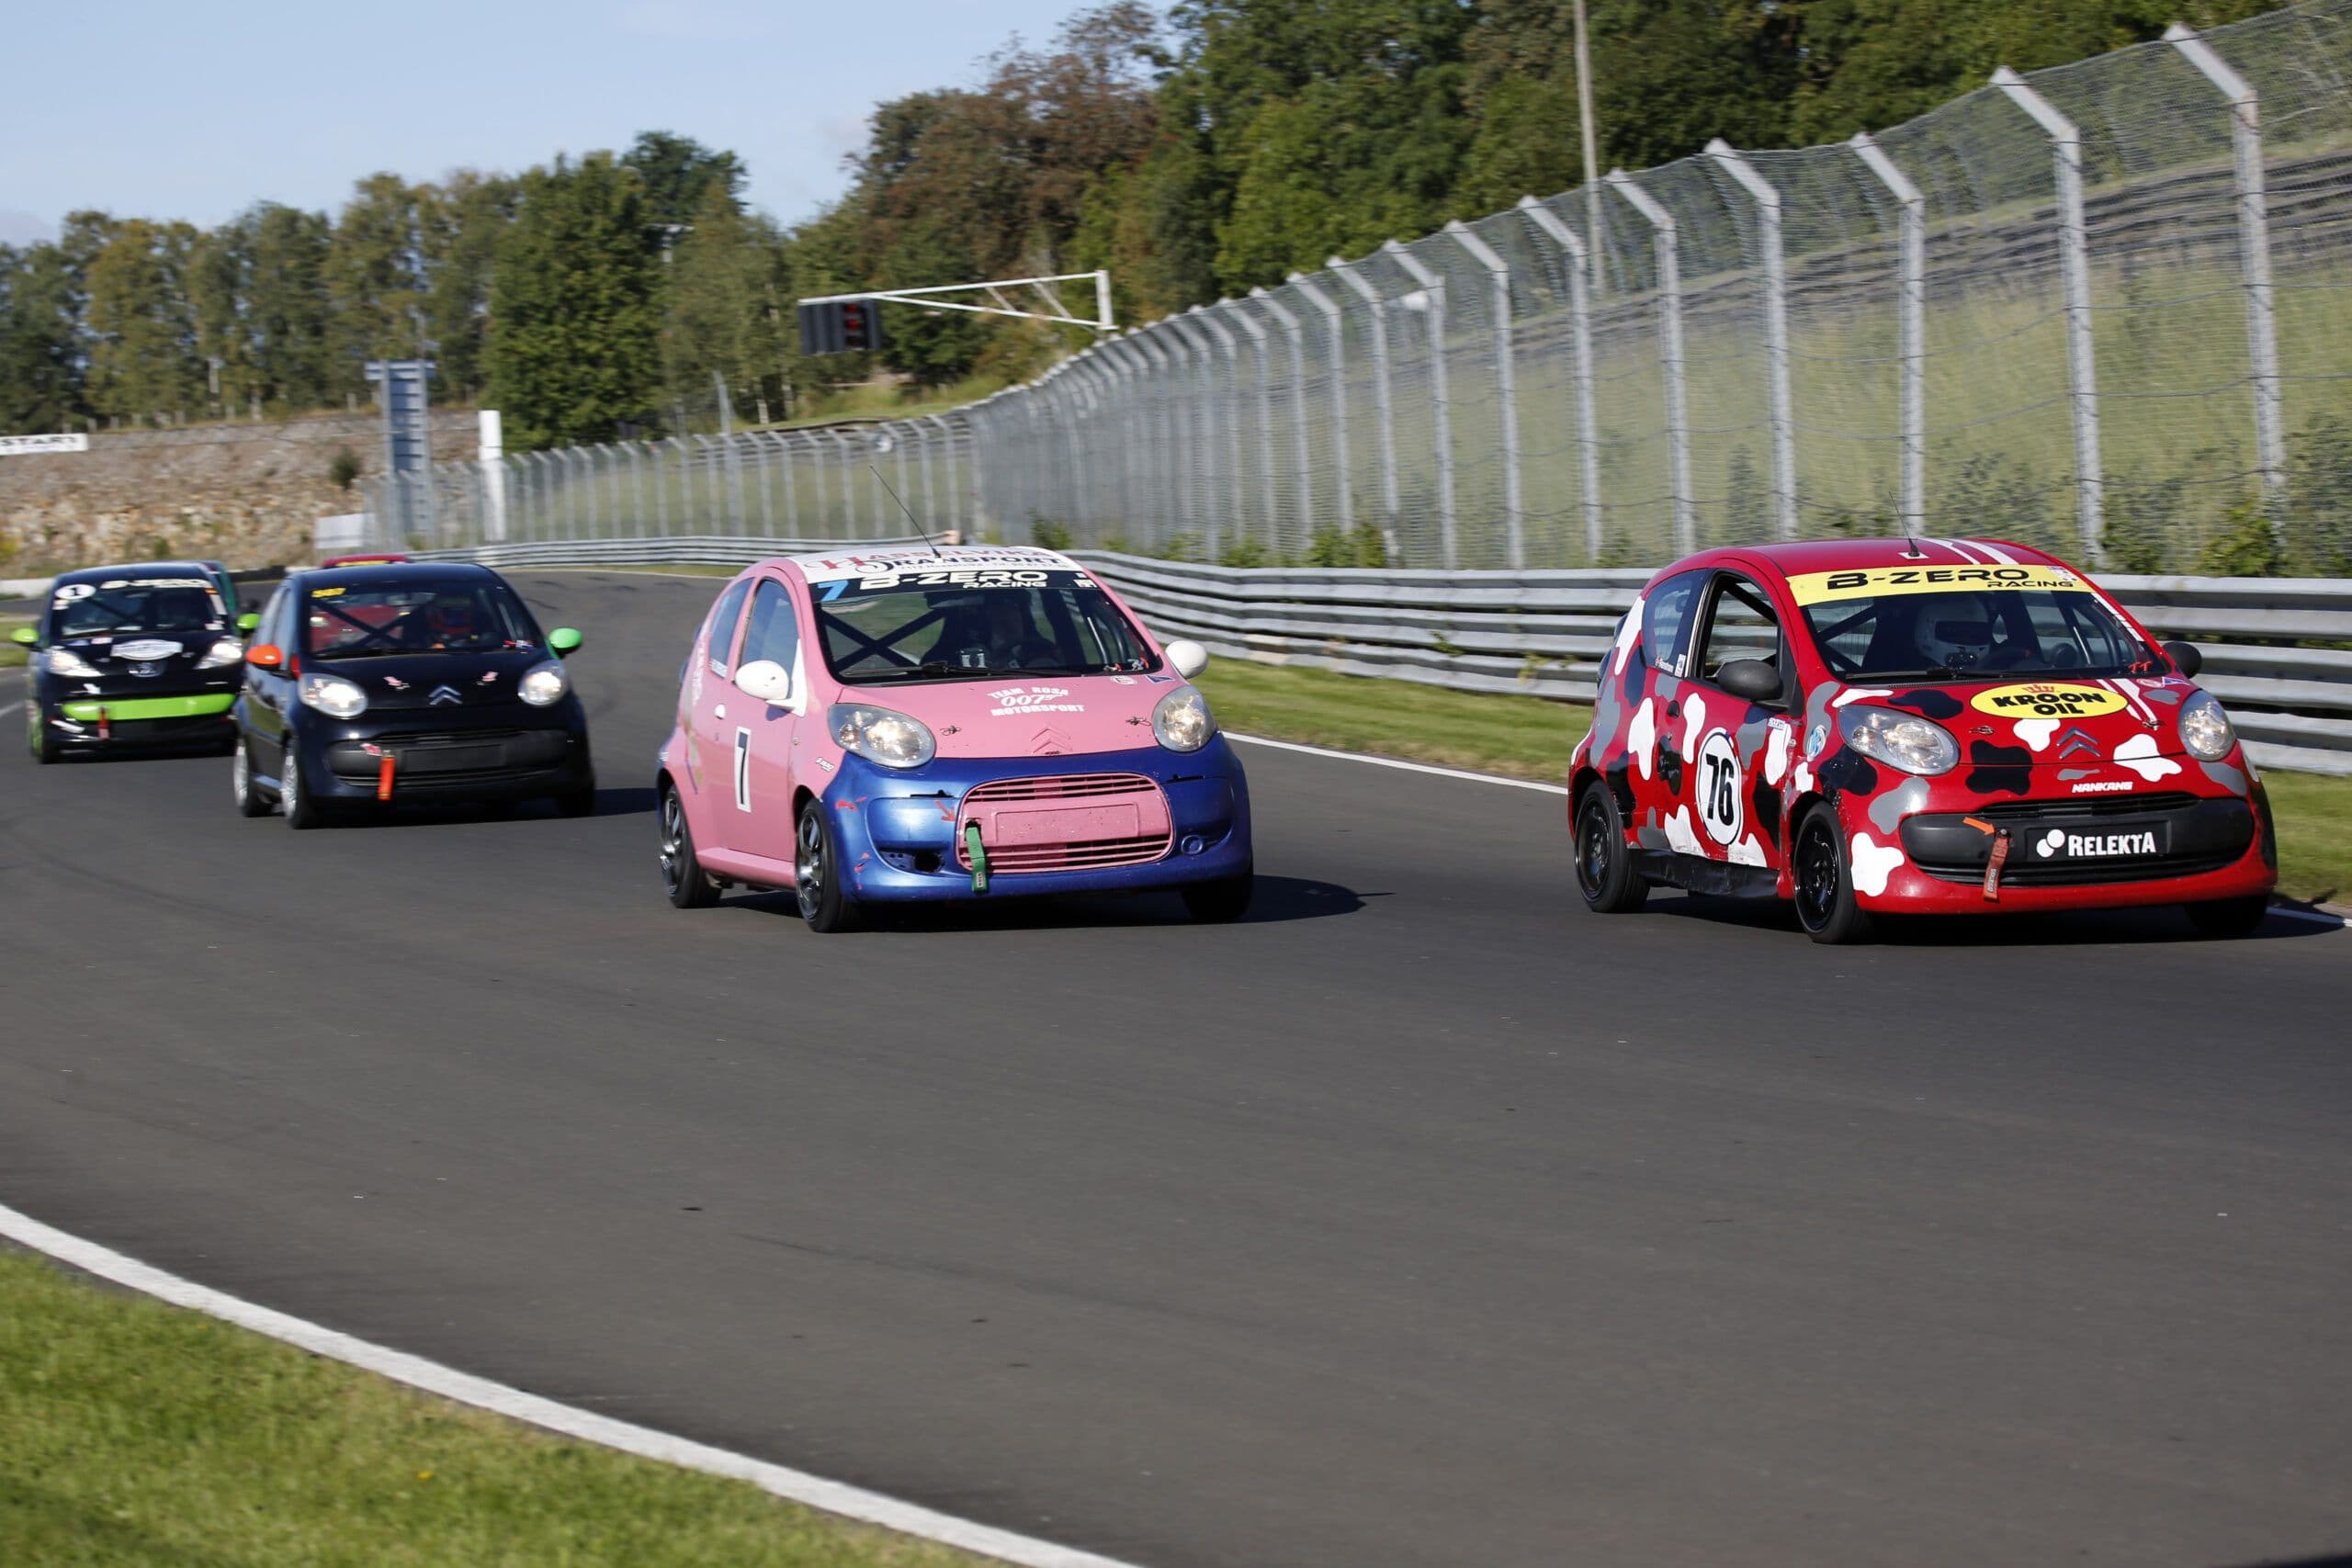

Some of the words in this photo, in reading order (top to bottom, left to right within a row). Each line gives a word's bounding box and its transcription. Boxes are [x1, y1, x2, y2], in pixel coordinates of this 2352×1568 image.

[963, 581, 1047, 589] RACING
[1827, 569, 2029, 590] B-ZERO
[817, 581, 849, 602] 7
[859, 571, 1048, 591] B-ZERO
[987, 687, 1025, 698] TEAM
[1031, 687, 1069, 696] ROSA
[1001, 694, 1063, 706] 007
[1992, 693, 2106, 707] KROON
[990, 705, 1085, 716] MOTORSPORT
[2033, 704, 2085, 716] OIL
[1705, 753, 1735, 826] 76
[2072, 782, 2133, 793] NANKANG
[2068, 831, 2156, 857] RELEKTA
